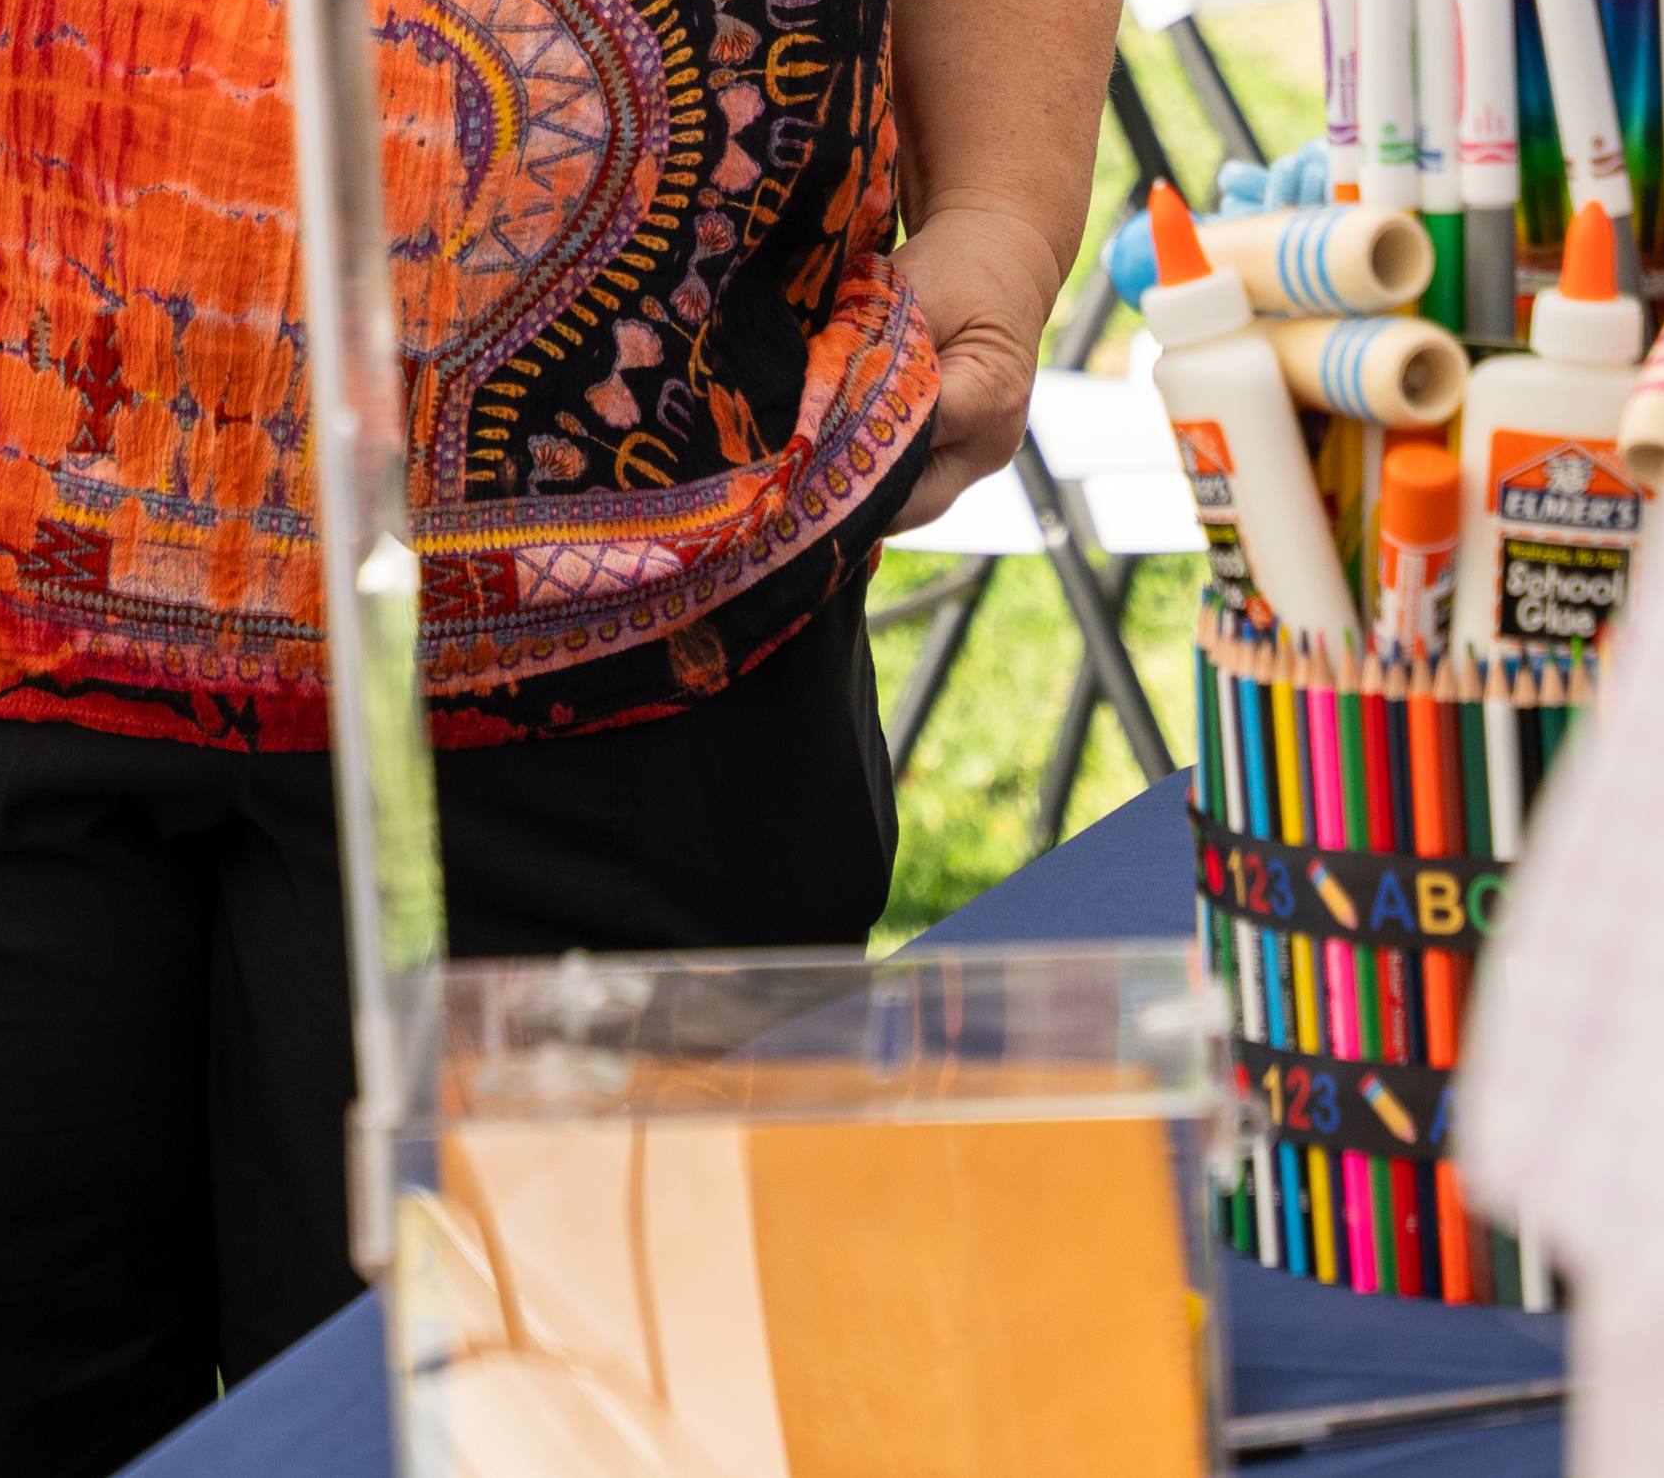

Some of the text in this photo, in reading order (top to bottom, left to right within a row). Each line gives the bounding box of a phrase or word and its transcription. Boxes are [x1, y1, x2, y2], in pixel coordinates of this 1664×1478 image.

[1503, 489, 1637, 529] ELMER'S
[1506, 559, 1623, 607] School
[1516, 596, 1597, 638] Glue
[1228, 846, 1513, 936] 123 ABC
[1261, 1063, 1341, 1133] 123
